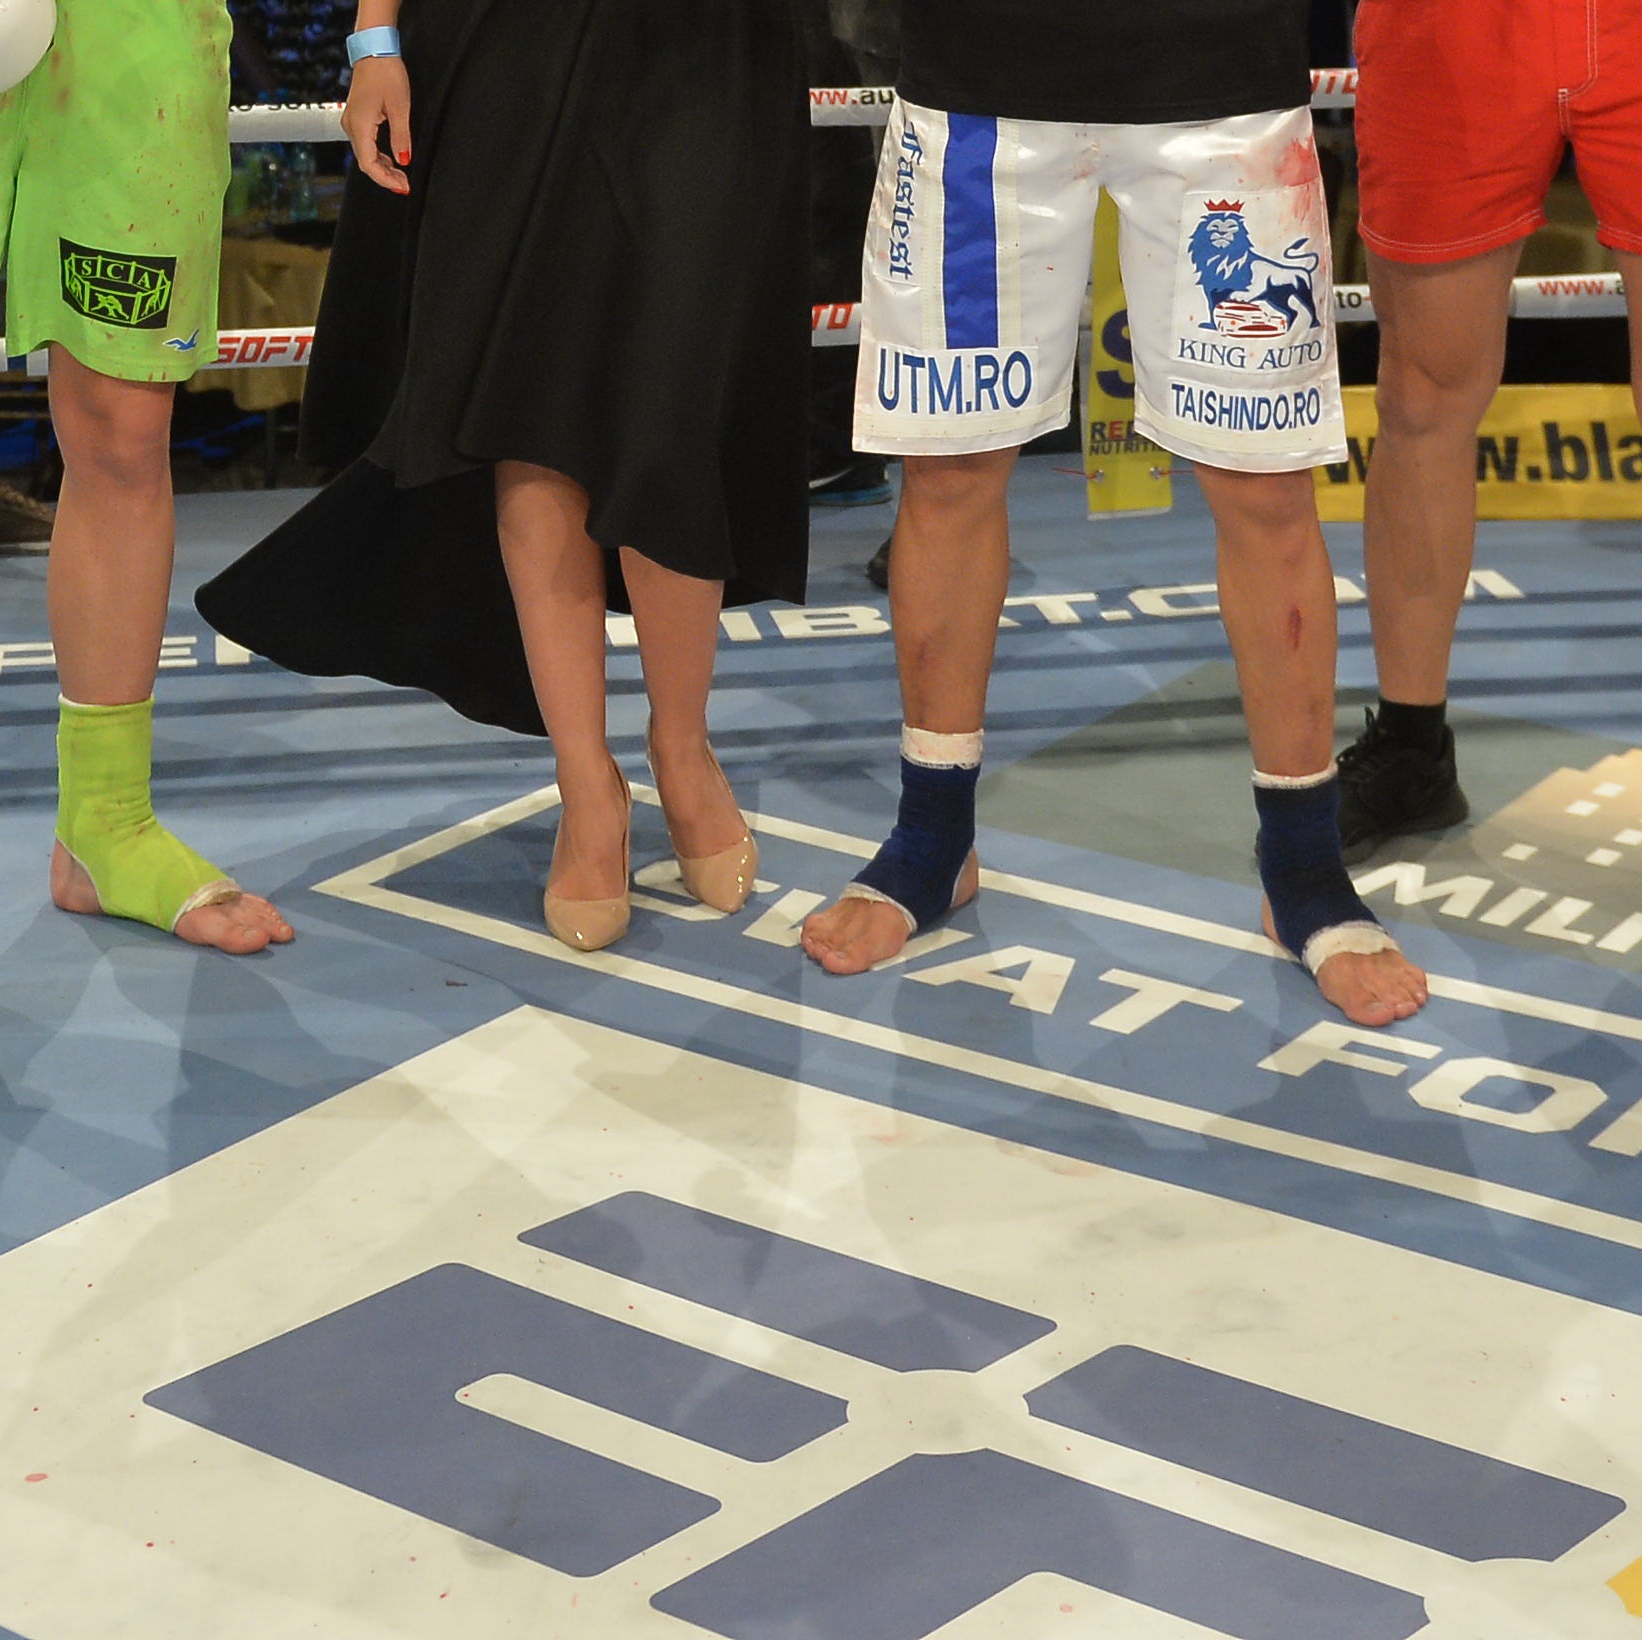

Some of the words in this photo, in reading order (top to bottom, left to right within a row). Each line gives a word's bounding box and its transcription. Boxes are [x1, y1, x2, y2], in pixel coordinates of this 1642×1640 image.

[216, 334, 313, 363] SOFT
[1177, 337, 1246, 370] KING
[1259, 338, 1322, 370] AUTO
[877, 348, 1032, 416] UTM.RO
[1170, 382, 1321, 432] TAISHINDO.RO
